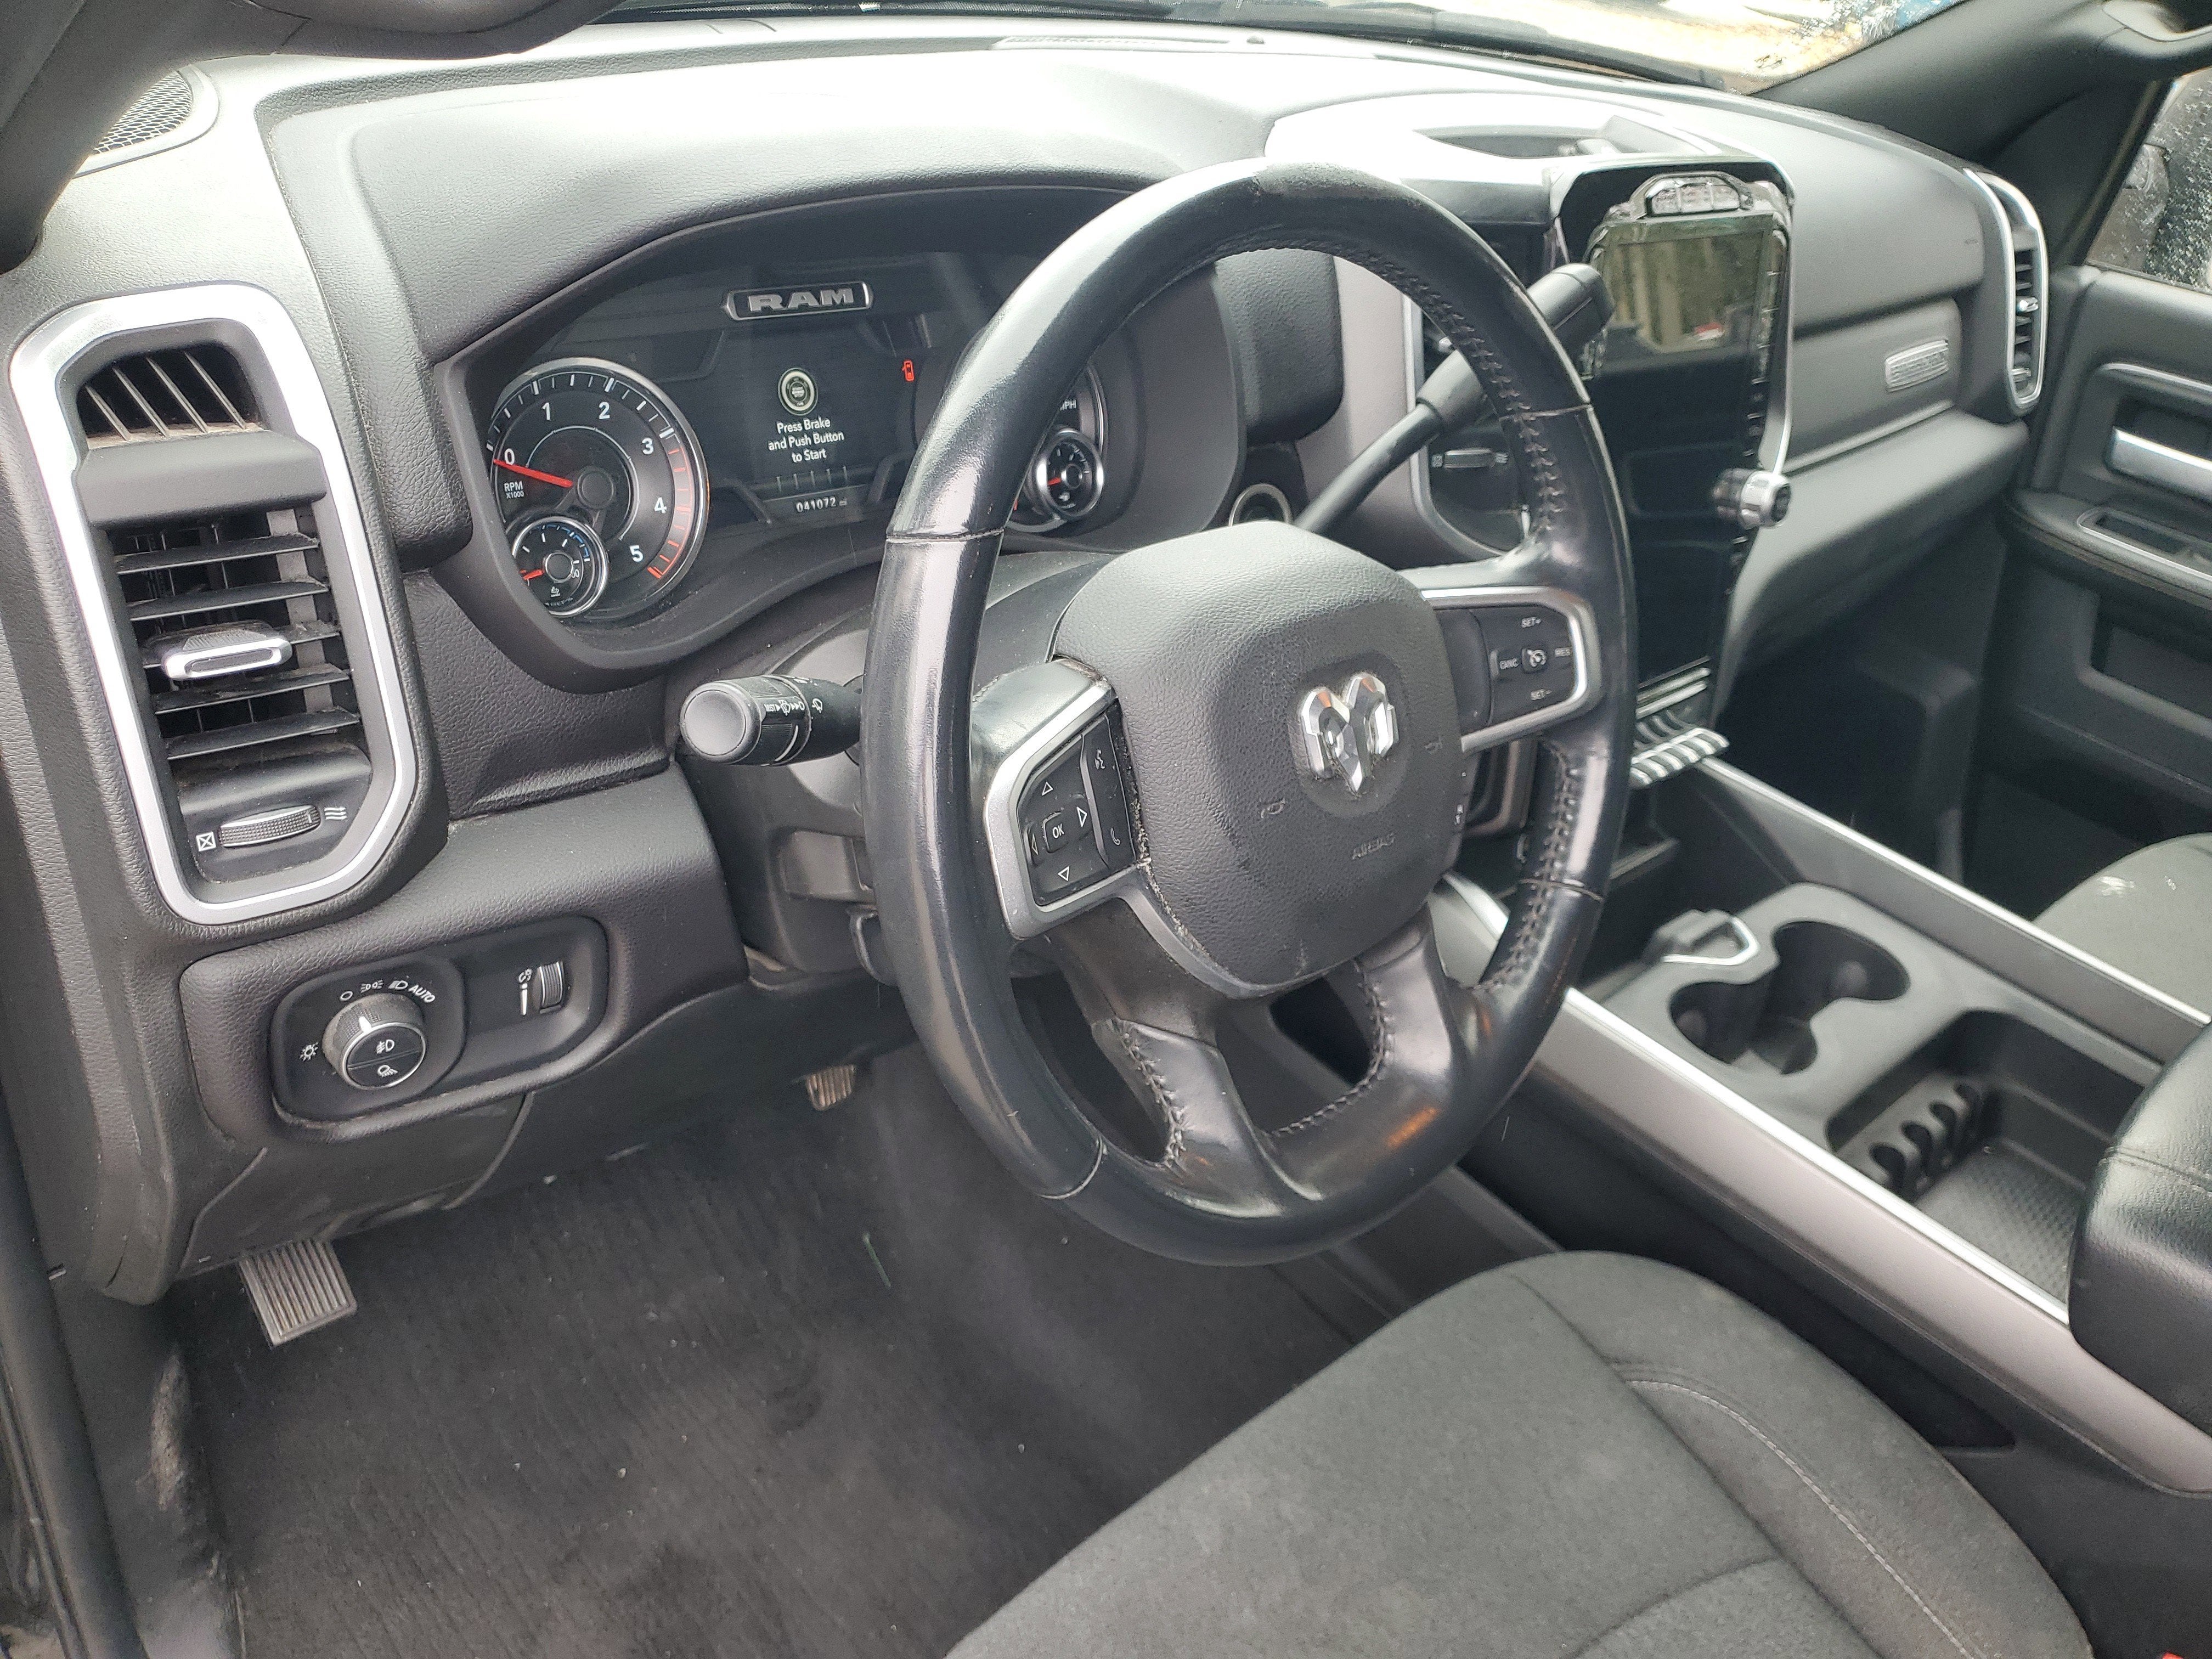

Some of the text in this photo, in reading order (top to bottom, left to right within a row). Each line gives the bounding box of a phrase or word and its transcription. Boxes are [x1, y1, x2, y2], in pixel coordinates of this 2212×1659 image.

[748, 288, 854, 312] RAM
[541, 402, 551, 421] 1
[598, 401, 611, 420] 2
[776, 415, 831, 434] Press Brake
[641, 437, 654, 455] 3
[768, 431, 844, 450] and Push Button
[504, 448, 515, 465] 0
[792, 448, 827, 463] to Start
[504, 481, 523, 492] RPM
[506, 490, 524, 499] X1000
[653, 496, 668, 514] 4
[795, 496, 837, 513] 041072
[629, 544, 644, 562] 5
[1052, 823, 1065, 839] OK
[408, 985, 436, 1003] AUTO
